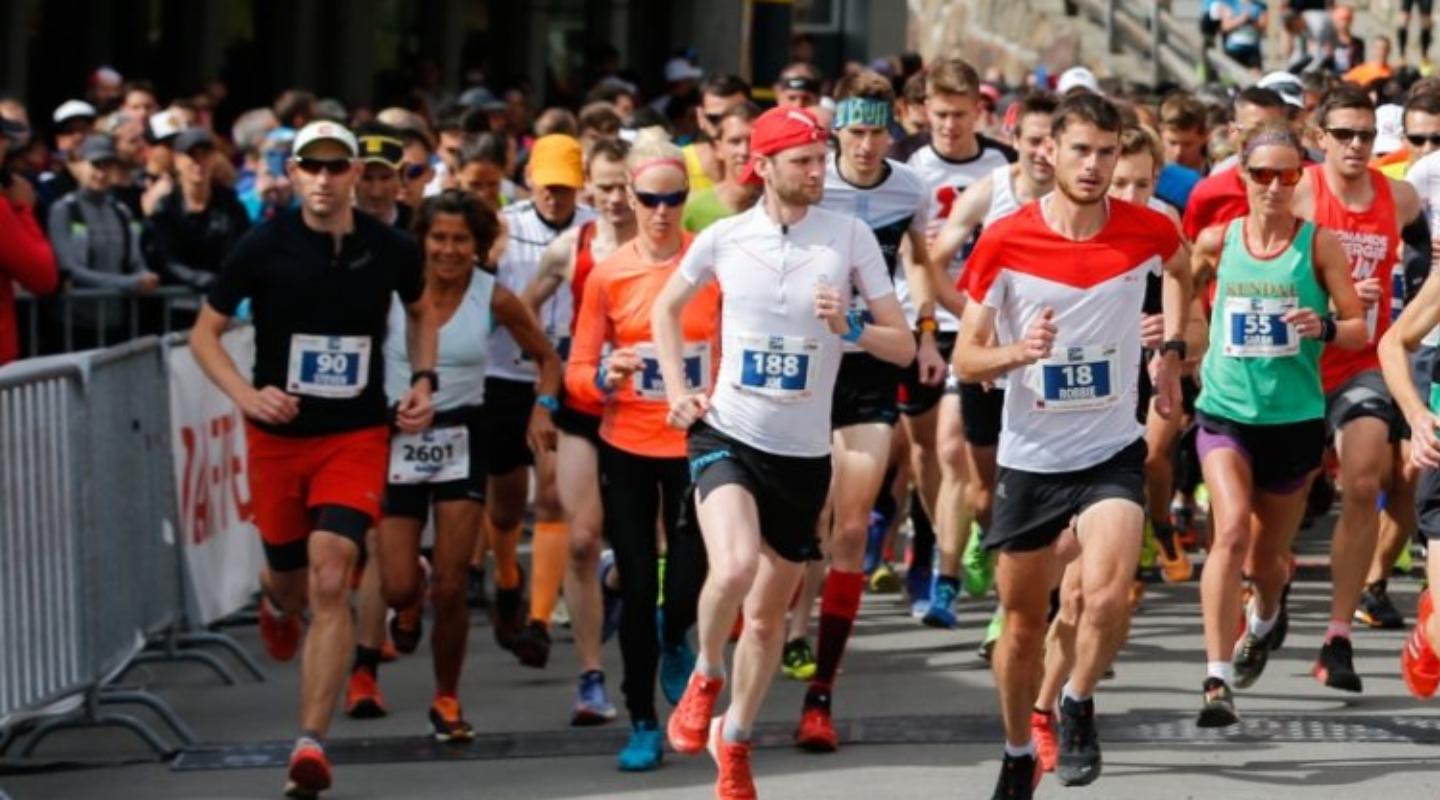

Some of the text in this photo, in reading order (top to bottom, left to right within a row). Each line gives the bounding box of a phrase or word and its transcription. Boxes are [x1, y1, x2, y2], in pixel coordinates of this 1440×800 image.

[1244, 315, 1272, 335] 55
[316, 352, 348, 374] 90
[752, 353, 800, 377] 188
[1061, 364, 1094, 387] 18
[403, 443, 454, 463] 2601
